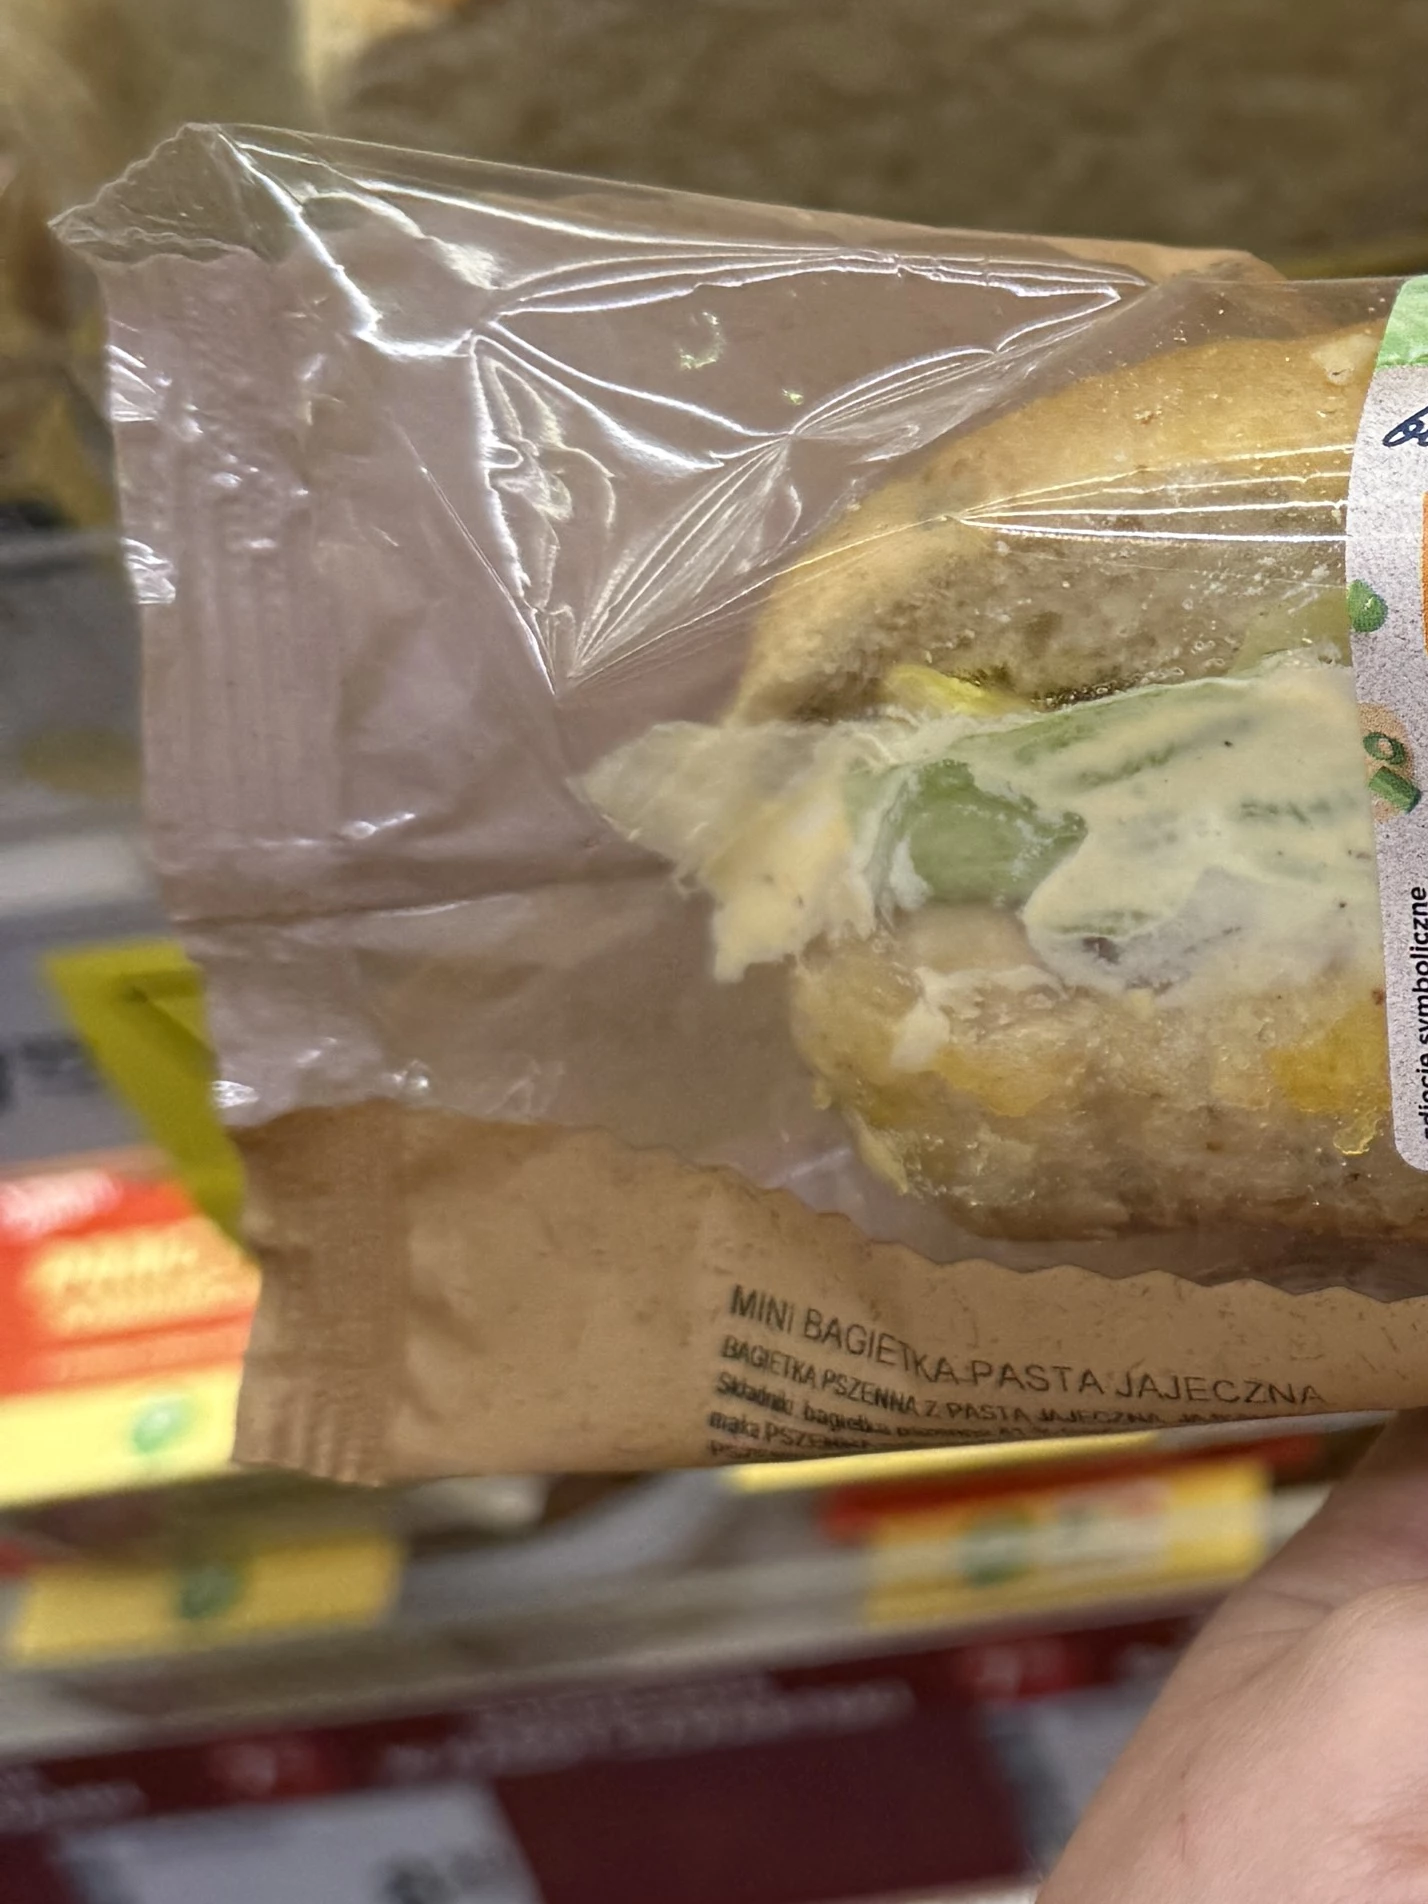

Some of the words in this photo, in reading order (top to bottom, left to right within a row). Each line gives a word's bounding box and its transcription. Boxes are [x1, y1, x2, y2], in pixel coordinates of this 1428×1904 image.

[719, 1334, 817, 1390] BAGIETKA
[822, 1368, 919, 1417] PSZENNA
[729, 1284, 795, 1335] MINI
[803, 1307, 961, 1386] BAGIETKA
[970, 1359, 1106, 1396] PASTA
[1115, 1371, 1330, 1406] JAJECZNA
